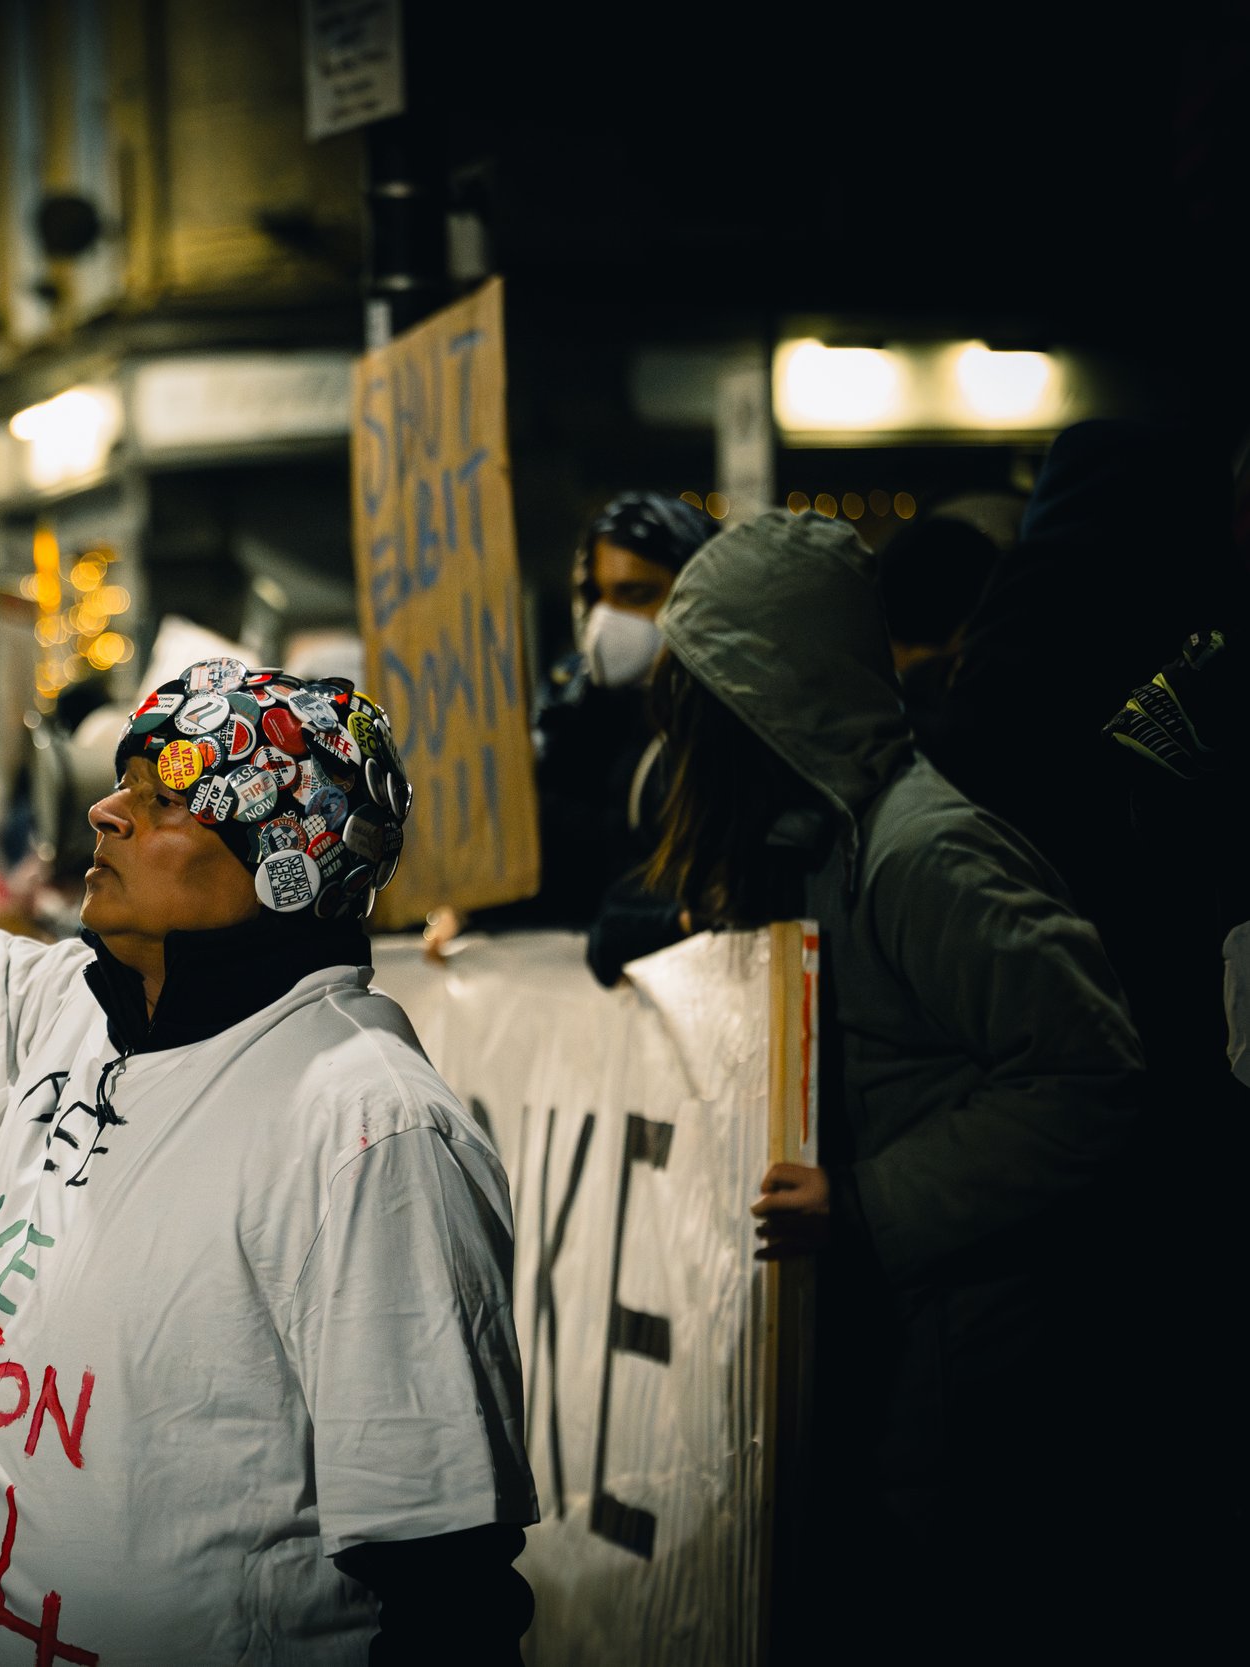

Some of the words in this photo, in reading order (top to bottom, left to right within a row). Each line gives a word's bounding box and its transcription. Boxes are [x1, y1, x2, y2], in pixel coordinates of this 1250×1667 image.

[159, 754, 172, 782] STOP
[169, 741, 186, 790] STARVING
[181, 747, 195, 777] GAZA
[275, 755, 289, 774] FREE
[190, 782, 210, 815] ISRAEL
[240, 776, 274, 803] FIRE
[215, 795, 234, 822] GAZA
[245, 797, 275, 822] NOW
[312, 835, 332, 857] STOP
[268, 862, 278, 882] THE
[276, 860, 294, 905] HUNGER
[290, 856, 311, 901] STRIKERS
[273, 885, 283, 907] FREE
